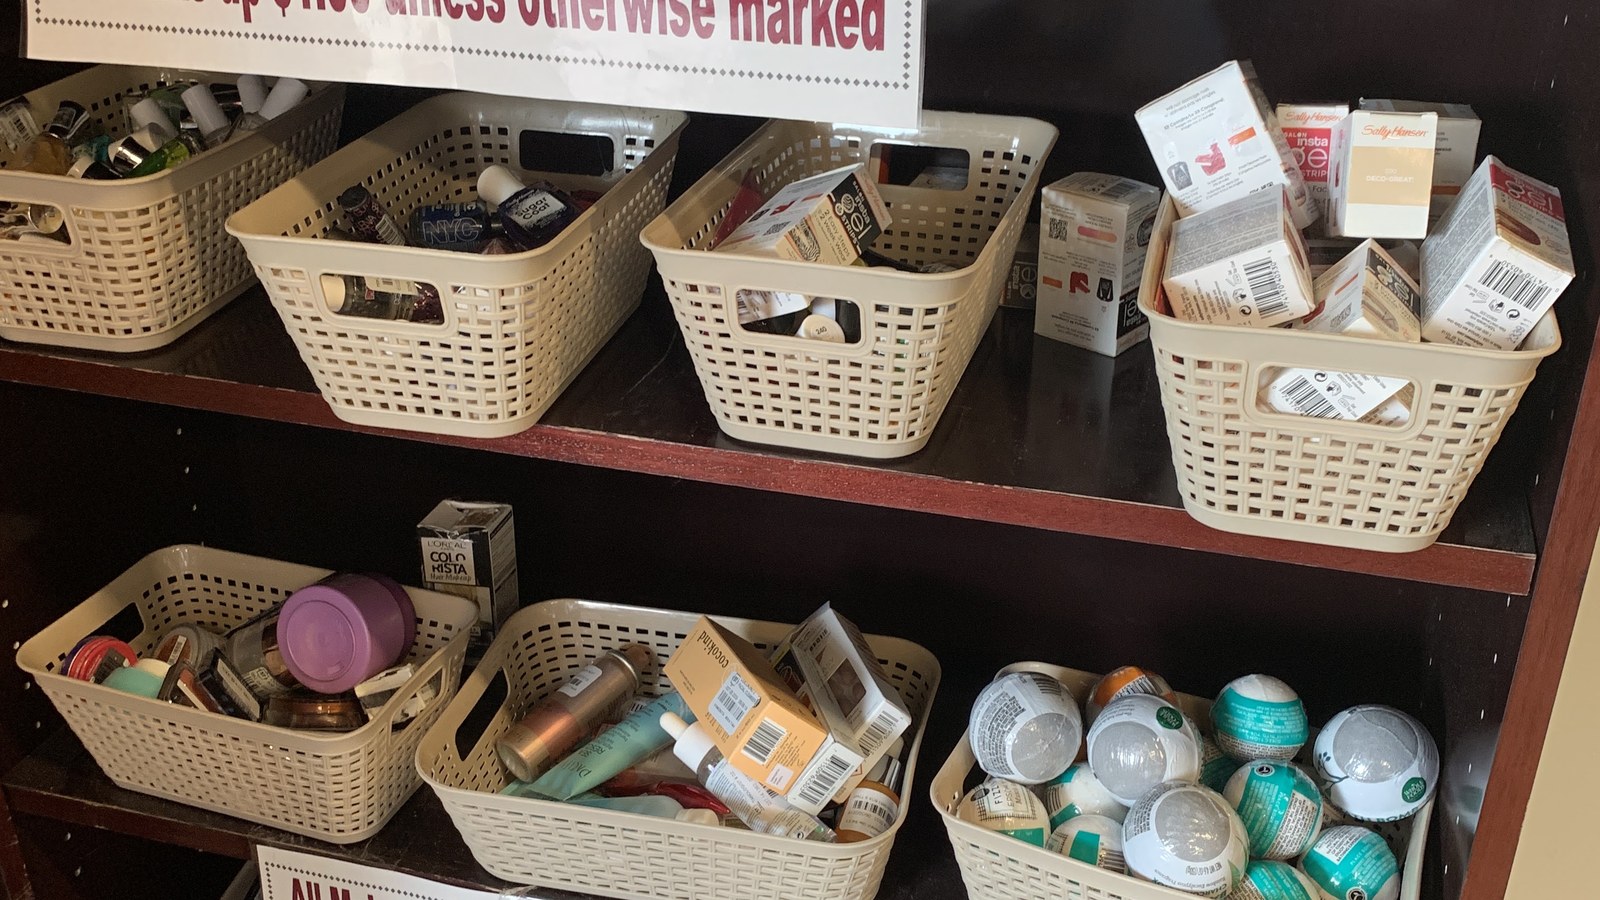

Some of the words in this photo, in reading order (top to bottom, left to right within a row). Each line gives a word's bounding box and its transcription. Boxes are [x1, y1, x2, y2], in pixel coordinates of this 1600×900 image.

[730, 0, 886, 51] marked
[1285, 111, 1311, 126] Sally
[1297, 133, 1328, 147] insta
[1361, 124, 1394, 138] Sally
[1393, 126, 1428, 138] Hansen
[1302, 169, 1328, 178] STRIP
[522, 201, 551, 221] Coat
[834, 193, 871, 239] gel
[854, 196, 872, 225] insta
[422, 217, 481, 245] NYC
[840, 215, 859, 244] STRIPS
[1270, 261, 1282, 284] 40530
[1501, 260, 1524, 275] 40530
[1524, 272, 1547, 287] 74170
[1277, 284, 1289, 305] 74170
[430, 551, 466, 563] COLO
[431, 562, 468, 576] RISTA
[697, 630, 730, 669] cocokind
